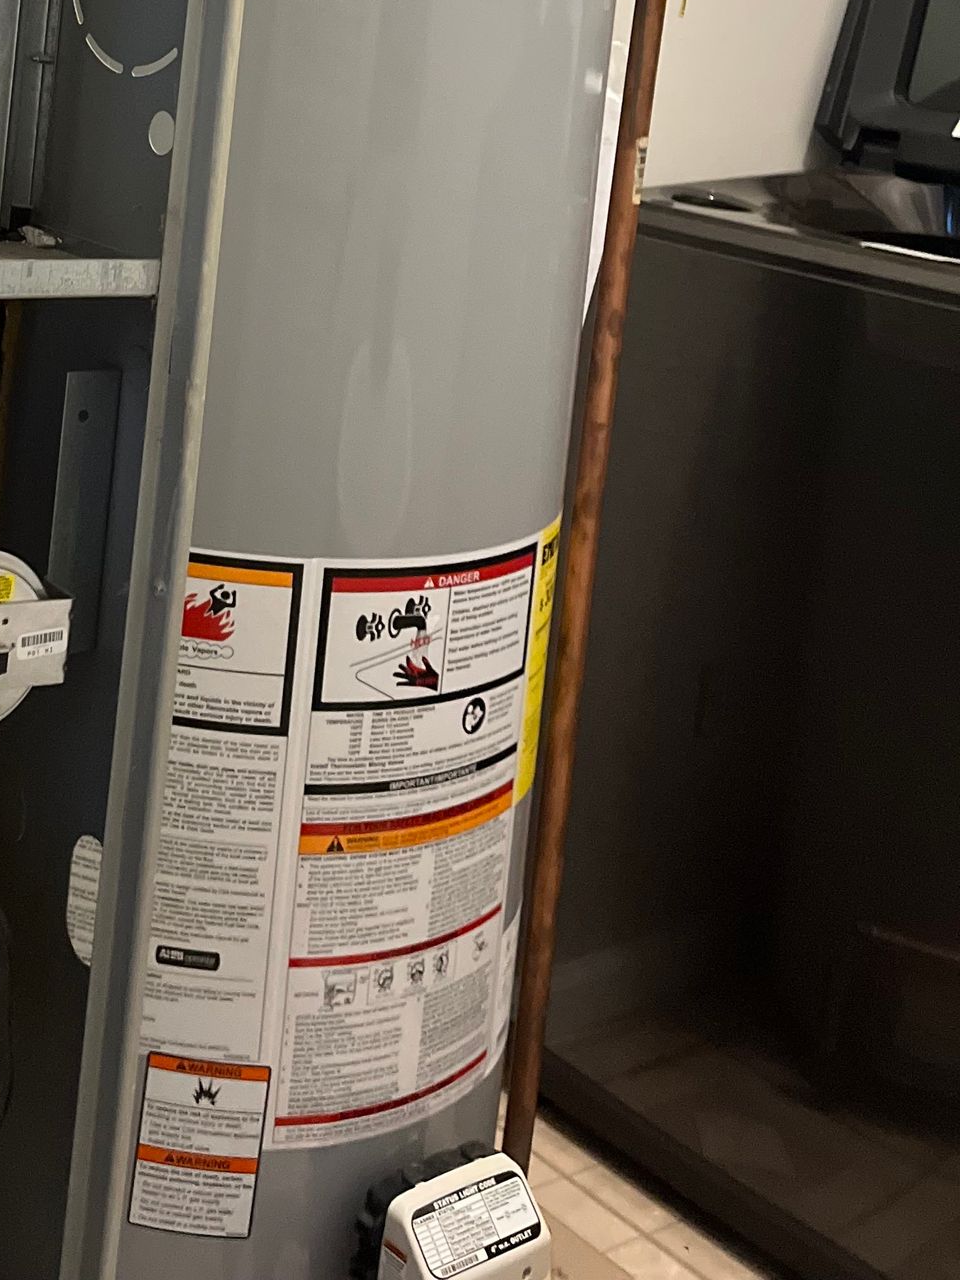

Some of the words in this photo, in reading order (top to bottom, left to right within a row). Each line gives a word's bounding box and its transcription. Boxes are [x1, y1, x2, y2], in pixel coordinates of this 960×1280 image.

[438, 571, 481, 587] DANGER
[192, 646, 218, 656] Vapors
[189, 1062, 241, 1077] WARNING
[176, 1155, 230, 1169] WARNING
[433, 1193, 459, 1210] STATUS
[458, 1185, 479, 1202] LIGHT
[478, 1177, 497, 1191] CODE
[510, 1228, 533, 1246] OUTLET
